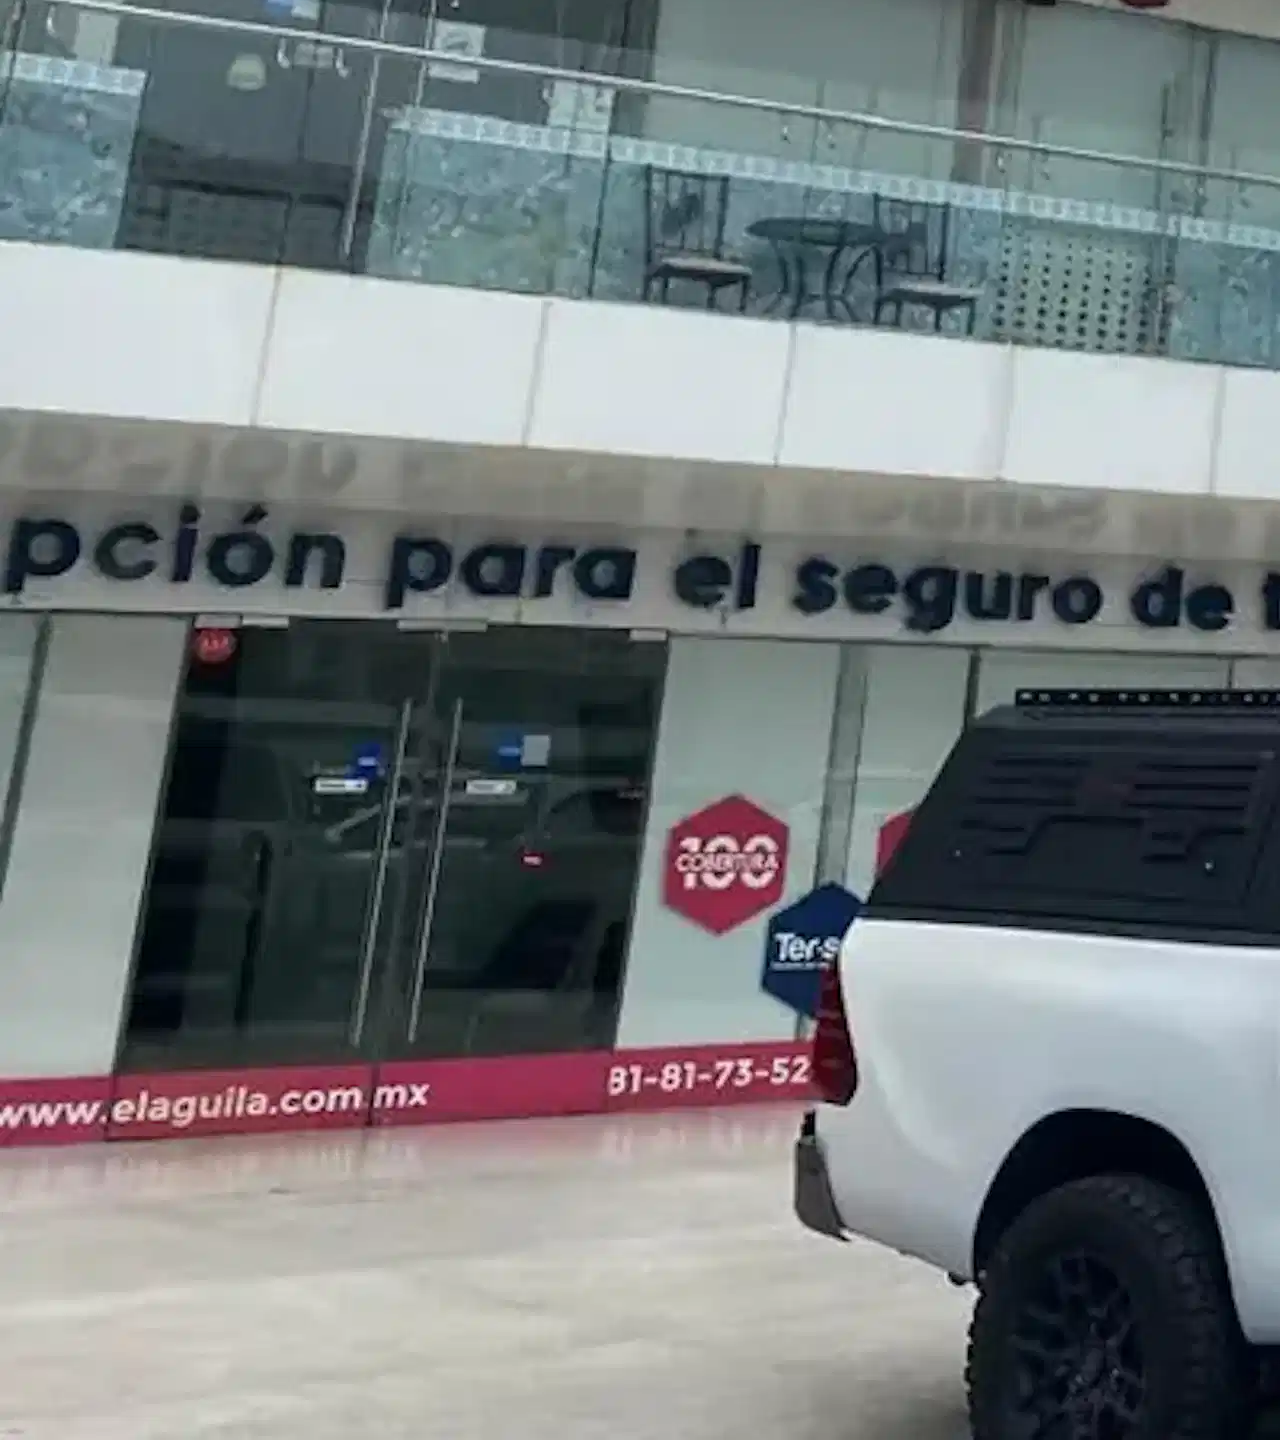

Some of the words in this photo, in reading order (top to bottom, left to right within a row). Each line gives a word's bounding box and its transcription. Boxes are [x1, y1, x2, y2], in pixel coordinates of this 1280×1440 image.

[5, 503, 347, 593] pción
[386, 533, 639, 610] para
[674, 542, 762, 610] el
[792, 553, 1102, 634] seguro
[1131, 567, 1234, 631] de
[678, 834, 781, 892] 100
